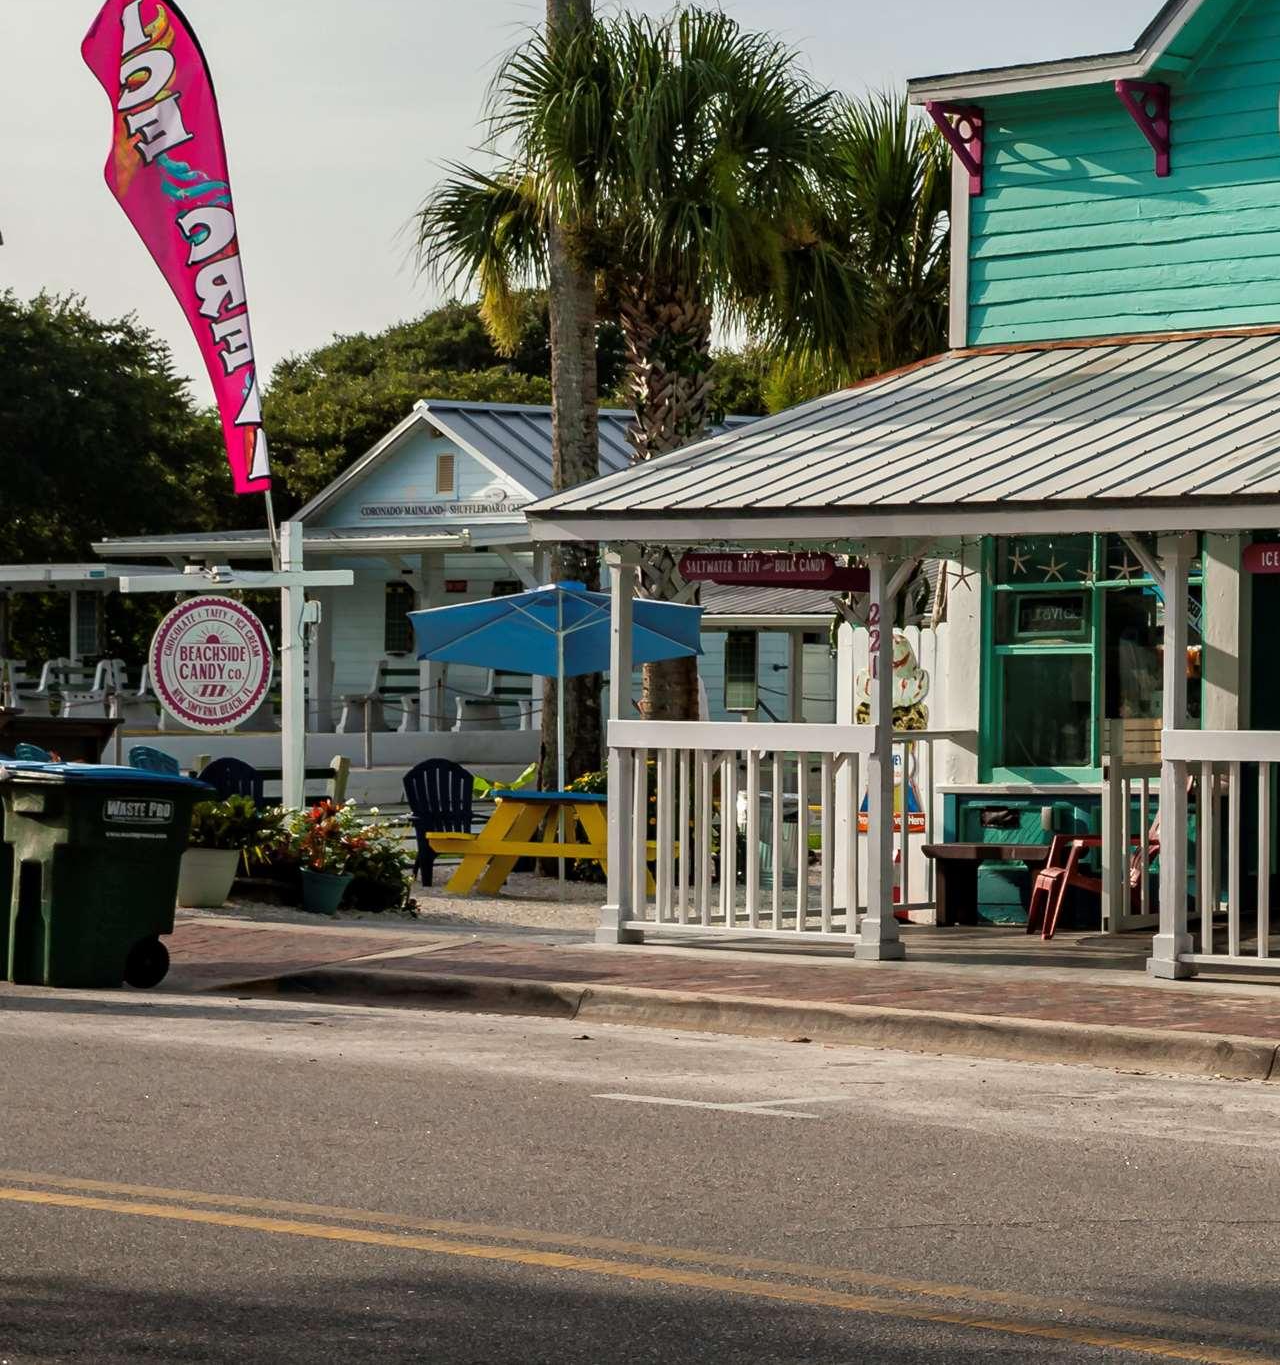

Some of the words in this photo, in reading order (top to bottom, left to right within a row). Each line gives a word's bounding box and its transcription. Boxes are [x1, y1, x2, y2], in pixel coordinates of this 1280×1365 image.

[685, 559, 734, 575] SALTWATER
[737, 559, 760, 574] TAFFY
[774, 558, 797, 573] BULK
[799, 557, 827, 572] CANDY
[1261, 551, 1279, 567] ICE
[163, 613, 196, 657] CHOCOLATE
[179, 645, 247, 662] BEACHSIDE
[179, 663, 226, 680] CANDY
[107, 800, 147, 816] WASTE
[148, 801, 171, 818] PRO
